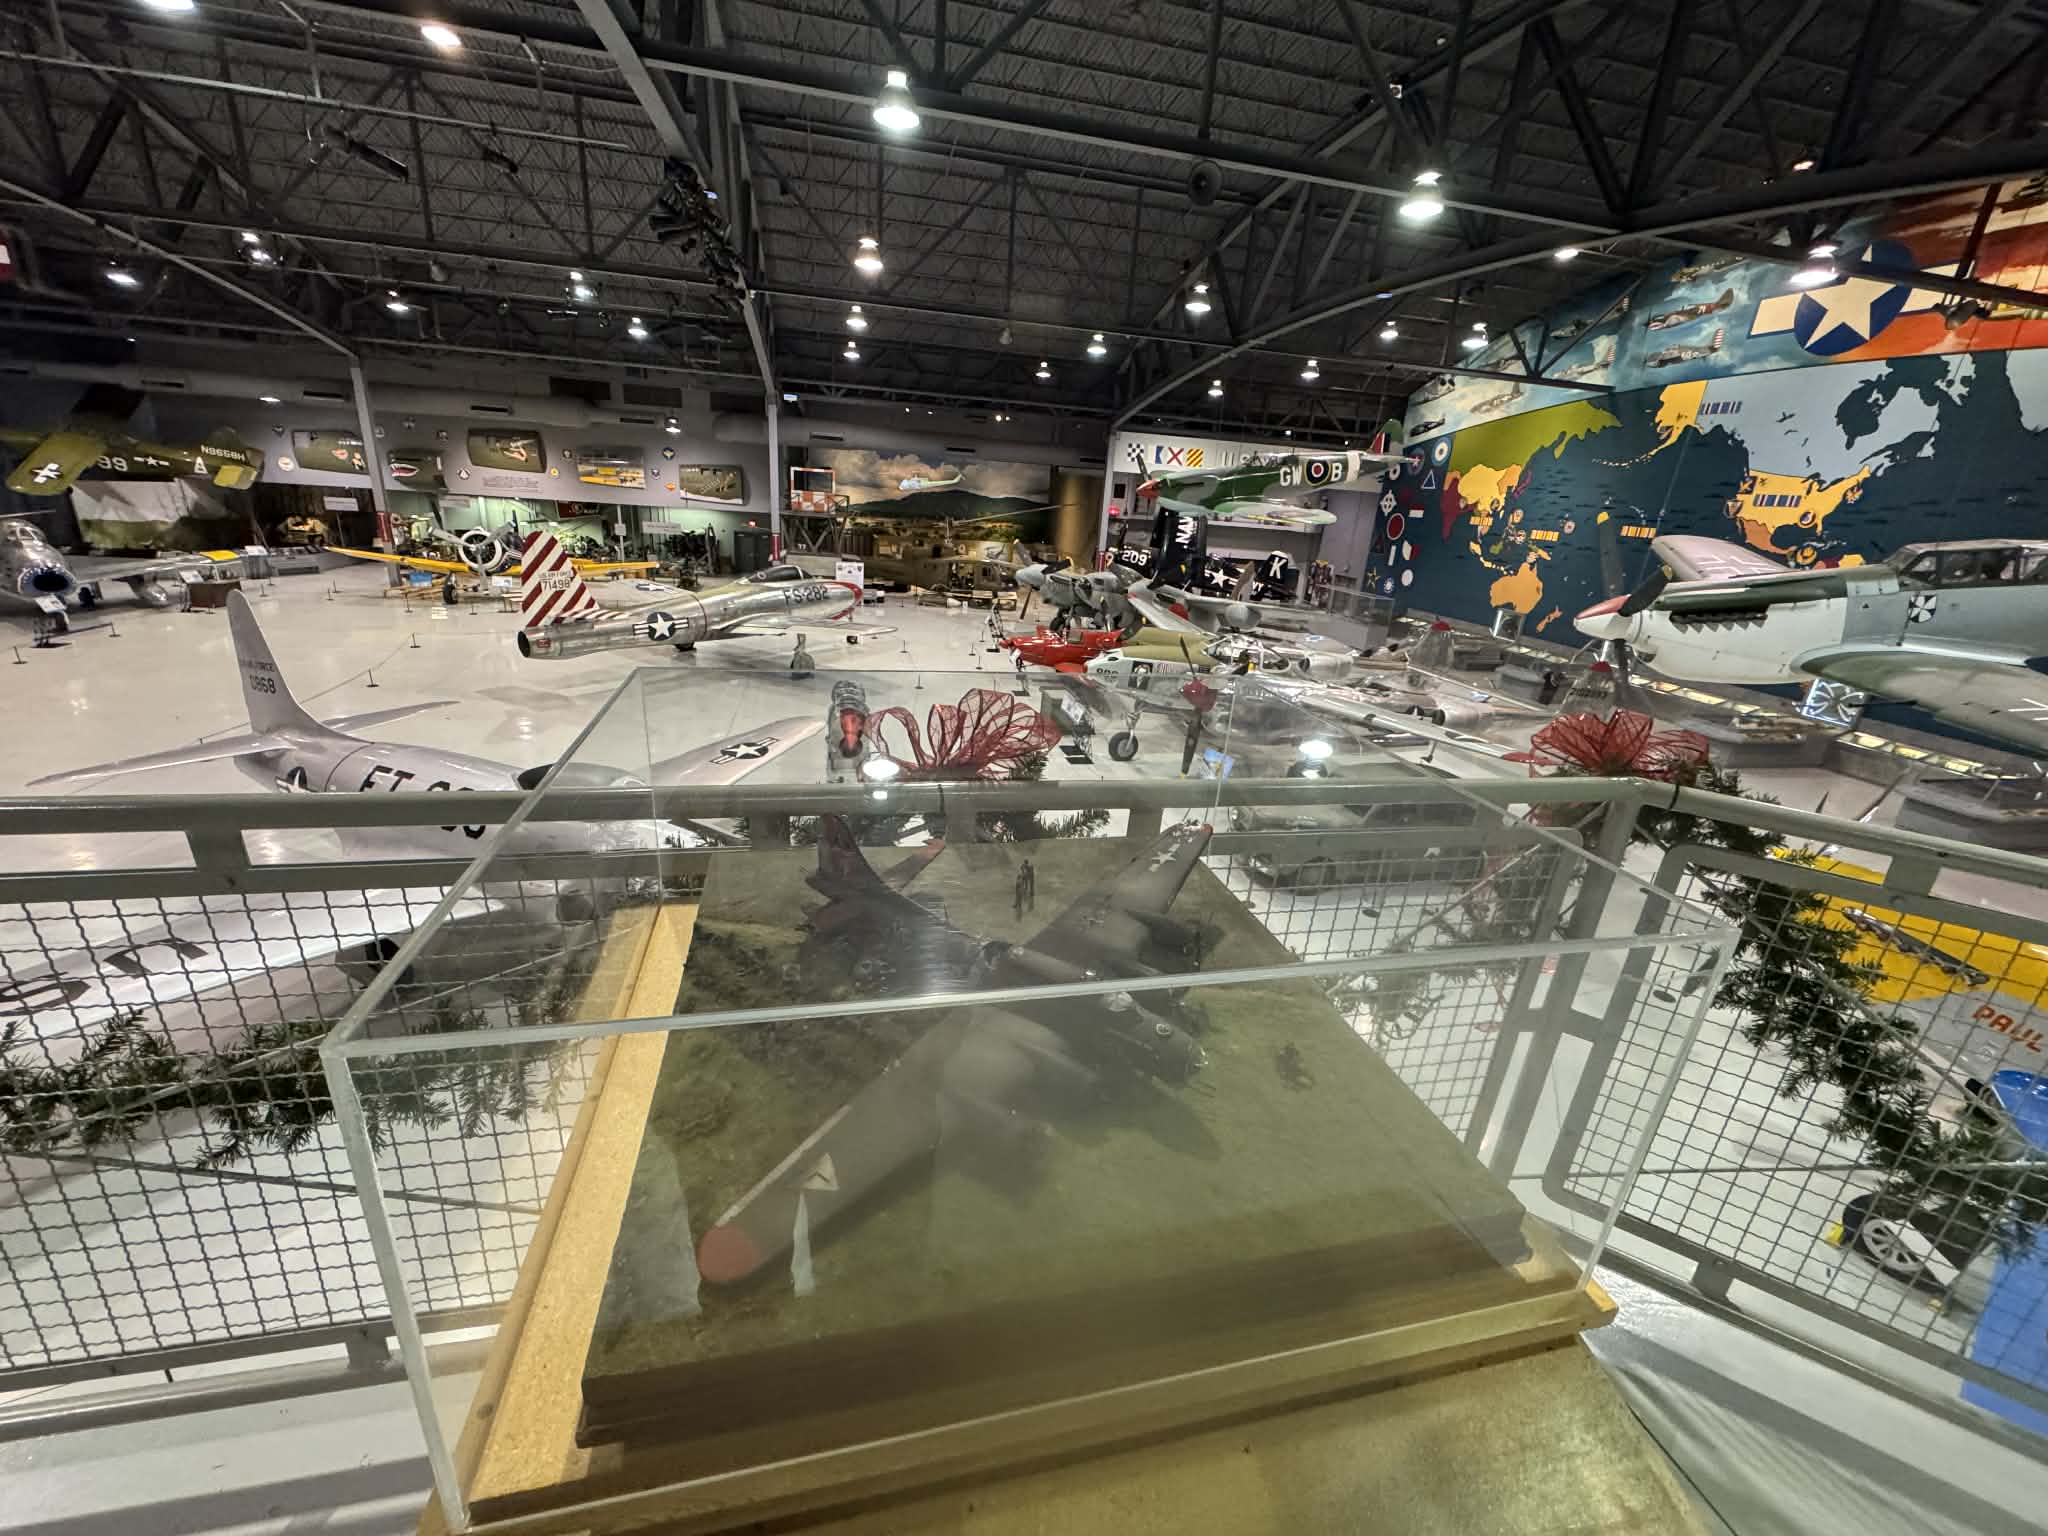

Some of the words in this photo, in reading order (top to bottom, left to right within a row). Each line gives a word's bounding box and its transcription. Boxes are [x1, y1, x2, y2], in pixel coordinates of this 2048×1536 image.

[1280, 464, 1304, 487] GW
[1331, 462, 1343, 483] B
[1175, 516, 1194, 544] NAV
[1121, 549, 1148, 566] 209
[1268, 557, 1288, 580] K
[1972, 1004, 2044, 1053] PAUL
